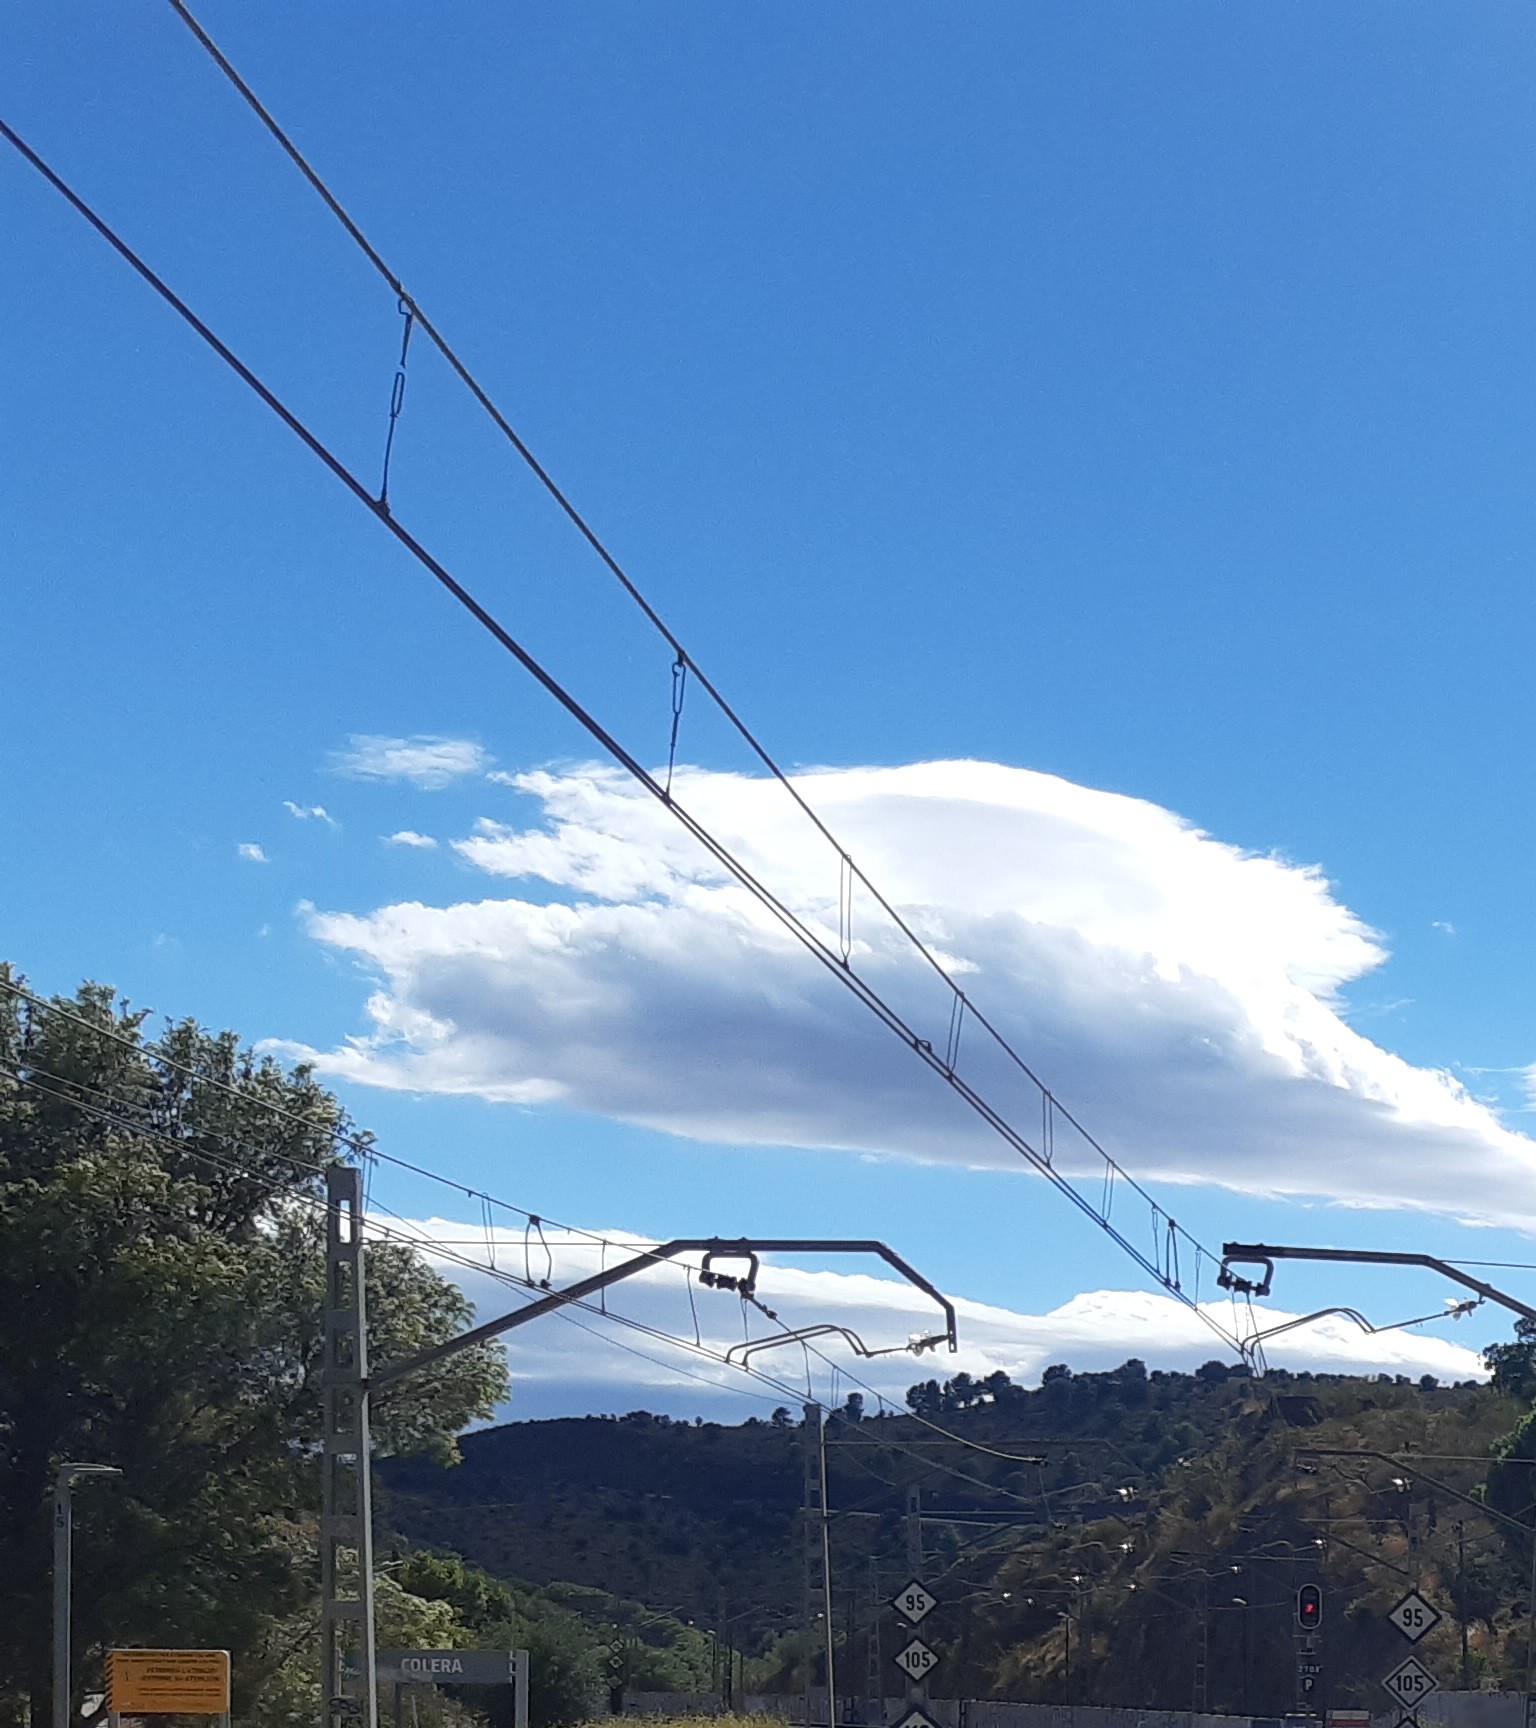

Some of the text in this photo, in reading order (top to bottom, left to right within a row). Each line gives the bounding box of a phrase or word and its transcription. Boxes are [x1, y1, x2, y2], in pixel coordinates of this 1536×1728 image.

[905, 1593, 926, 1612] 95
[1402, 1607, 1424, 1628] 95
[401, 1658, 464, 1674] COLERA
[904, 1651, 931, 1669] 105
[1396, 1674, 1425, 1692] 105
